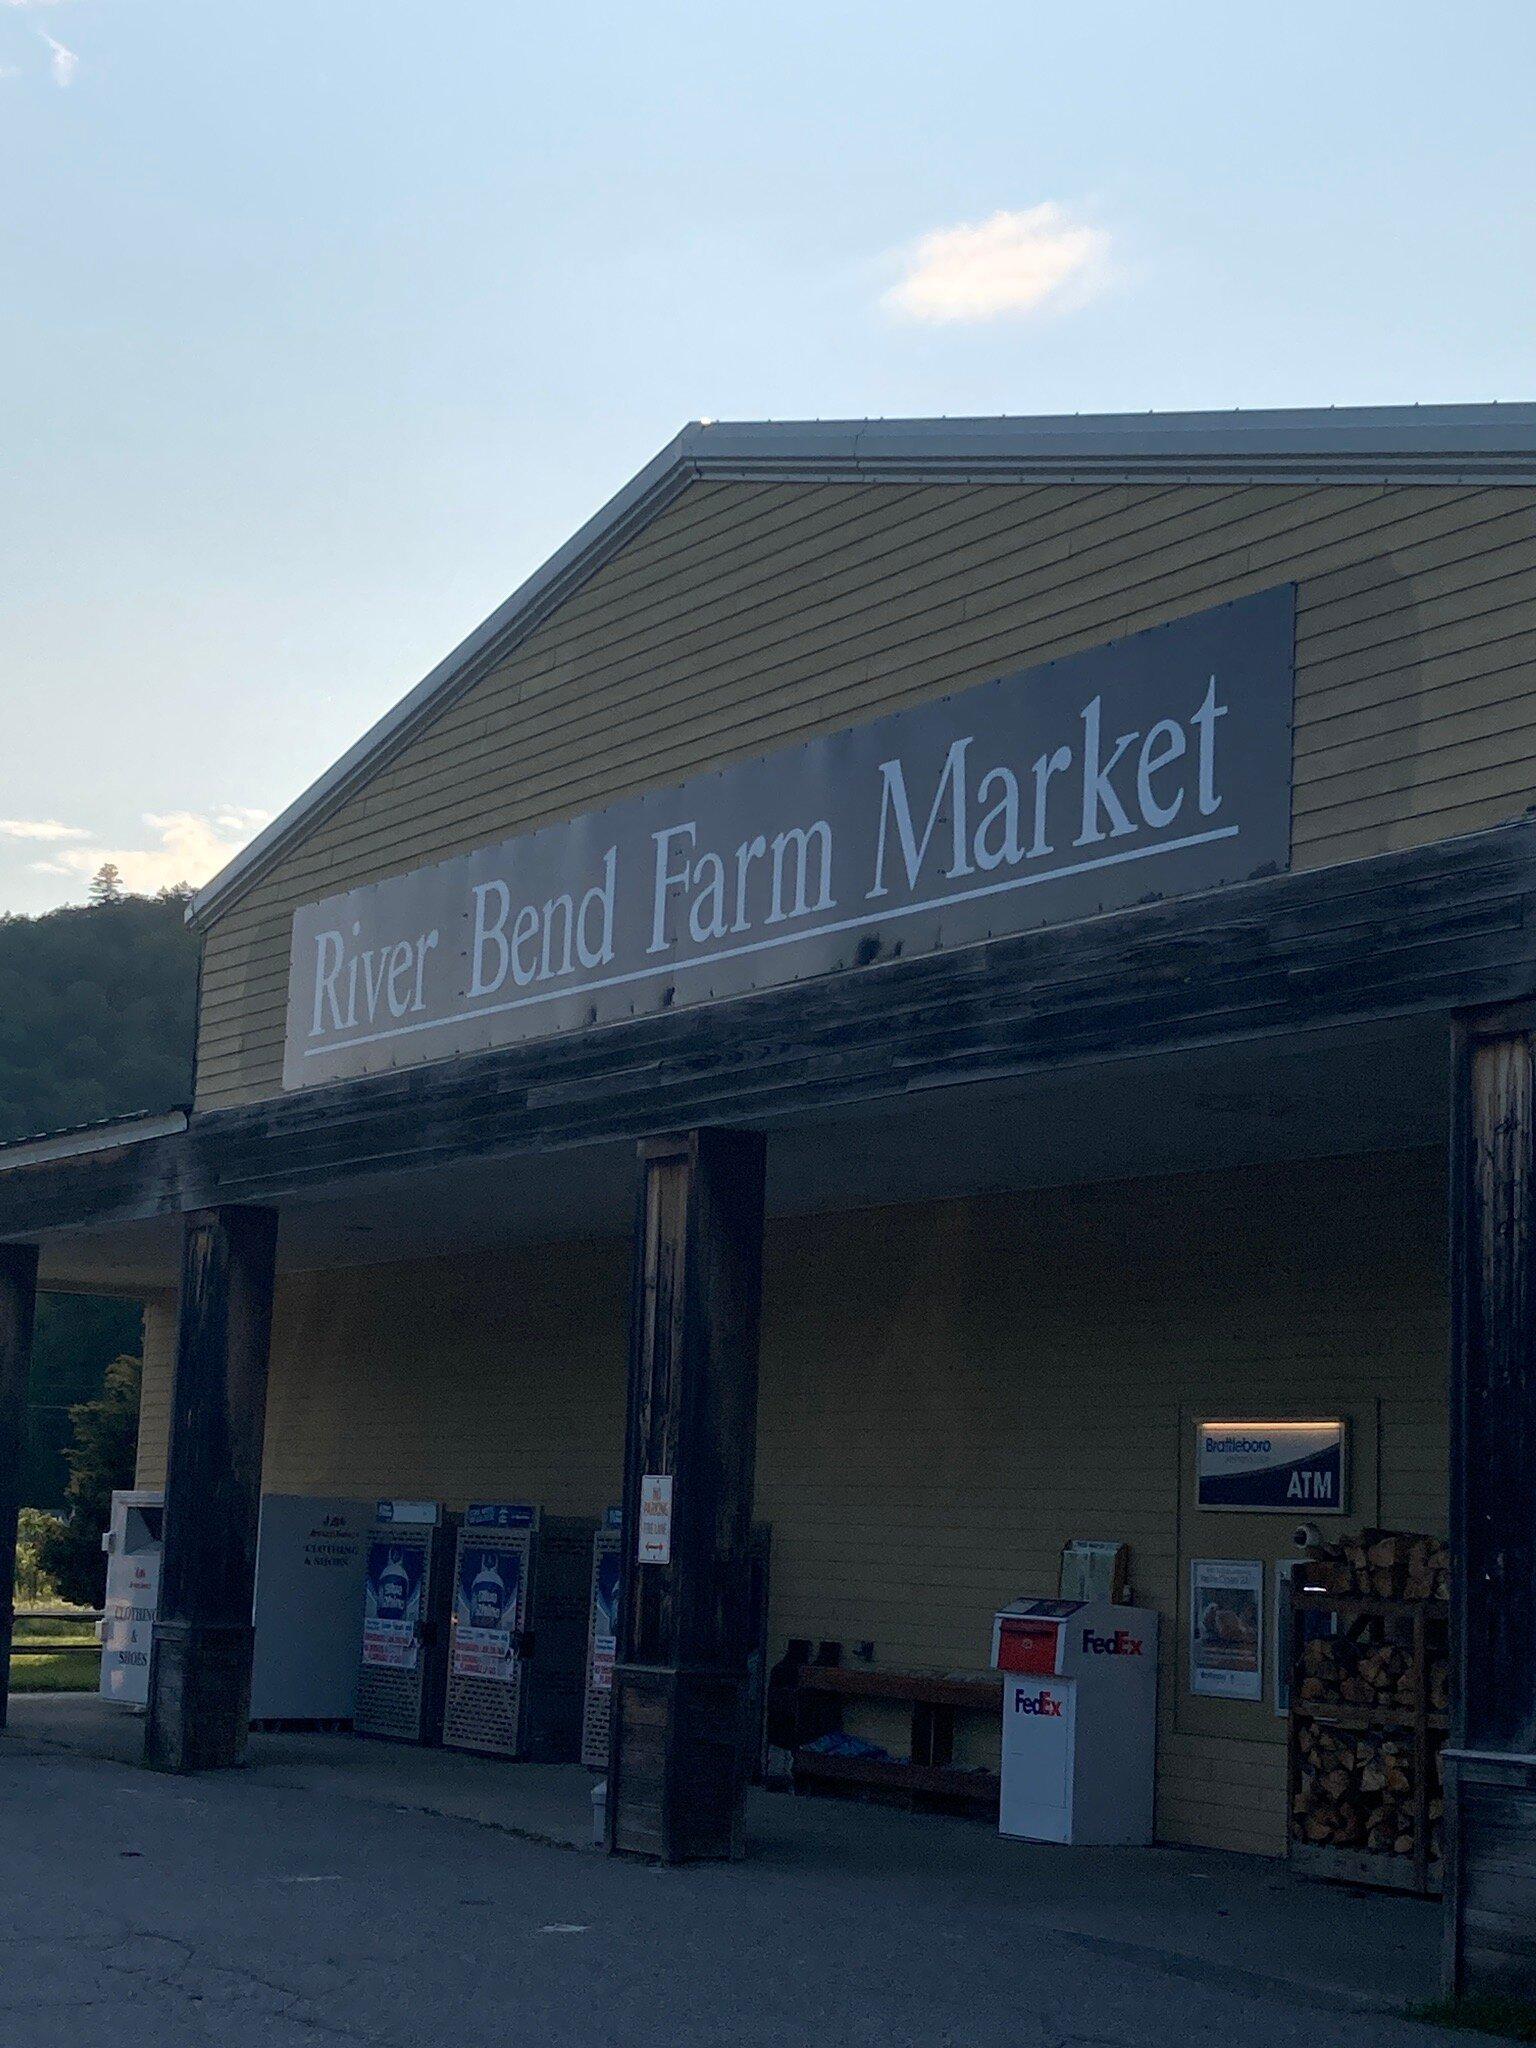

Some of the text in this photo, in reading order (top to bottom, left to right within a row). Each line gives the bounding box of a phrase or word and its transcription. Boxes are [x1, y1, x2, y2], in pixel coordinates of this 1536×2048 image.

[309, 673, 1229, 1037] River Bend Farm Market
[1206, 1437, 1272, 1454] Brattleboro
[1286, 1471, 1333, 1500] ATM
[1082, 1629, 1143, 1657] FedEx
[1015, 1688, 1062, 1717] FedEx
